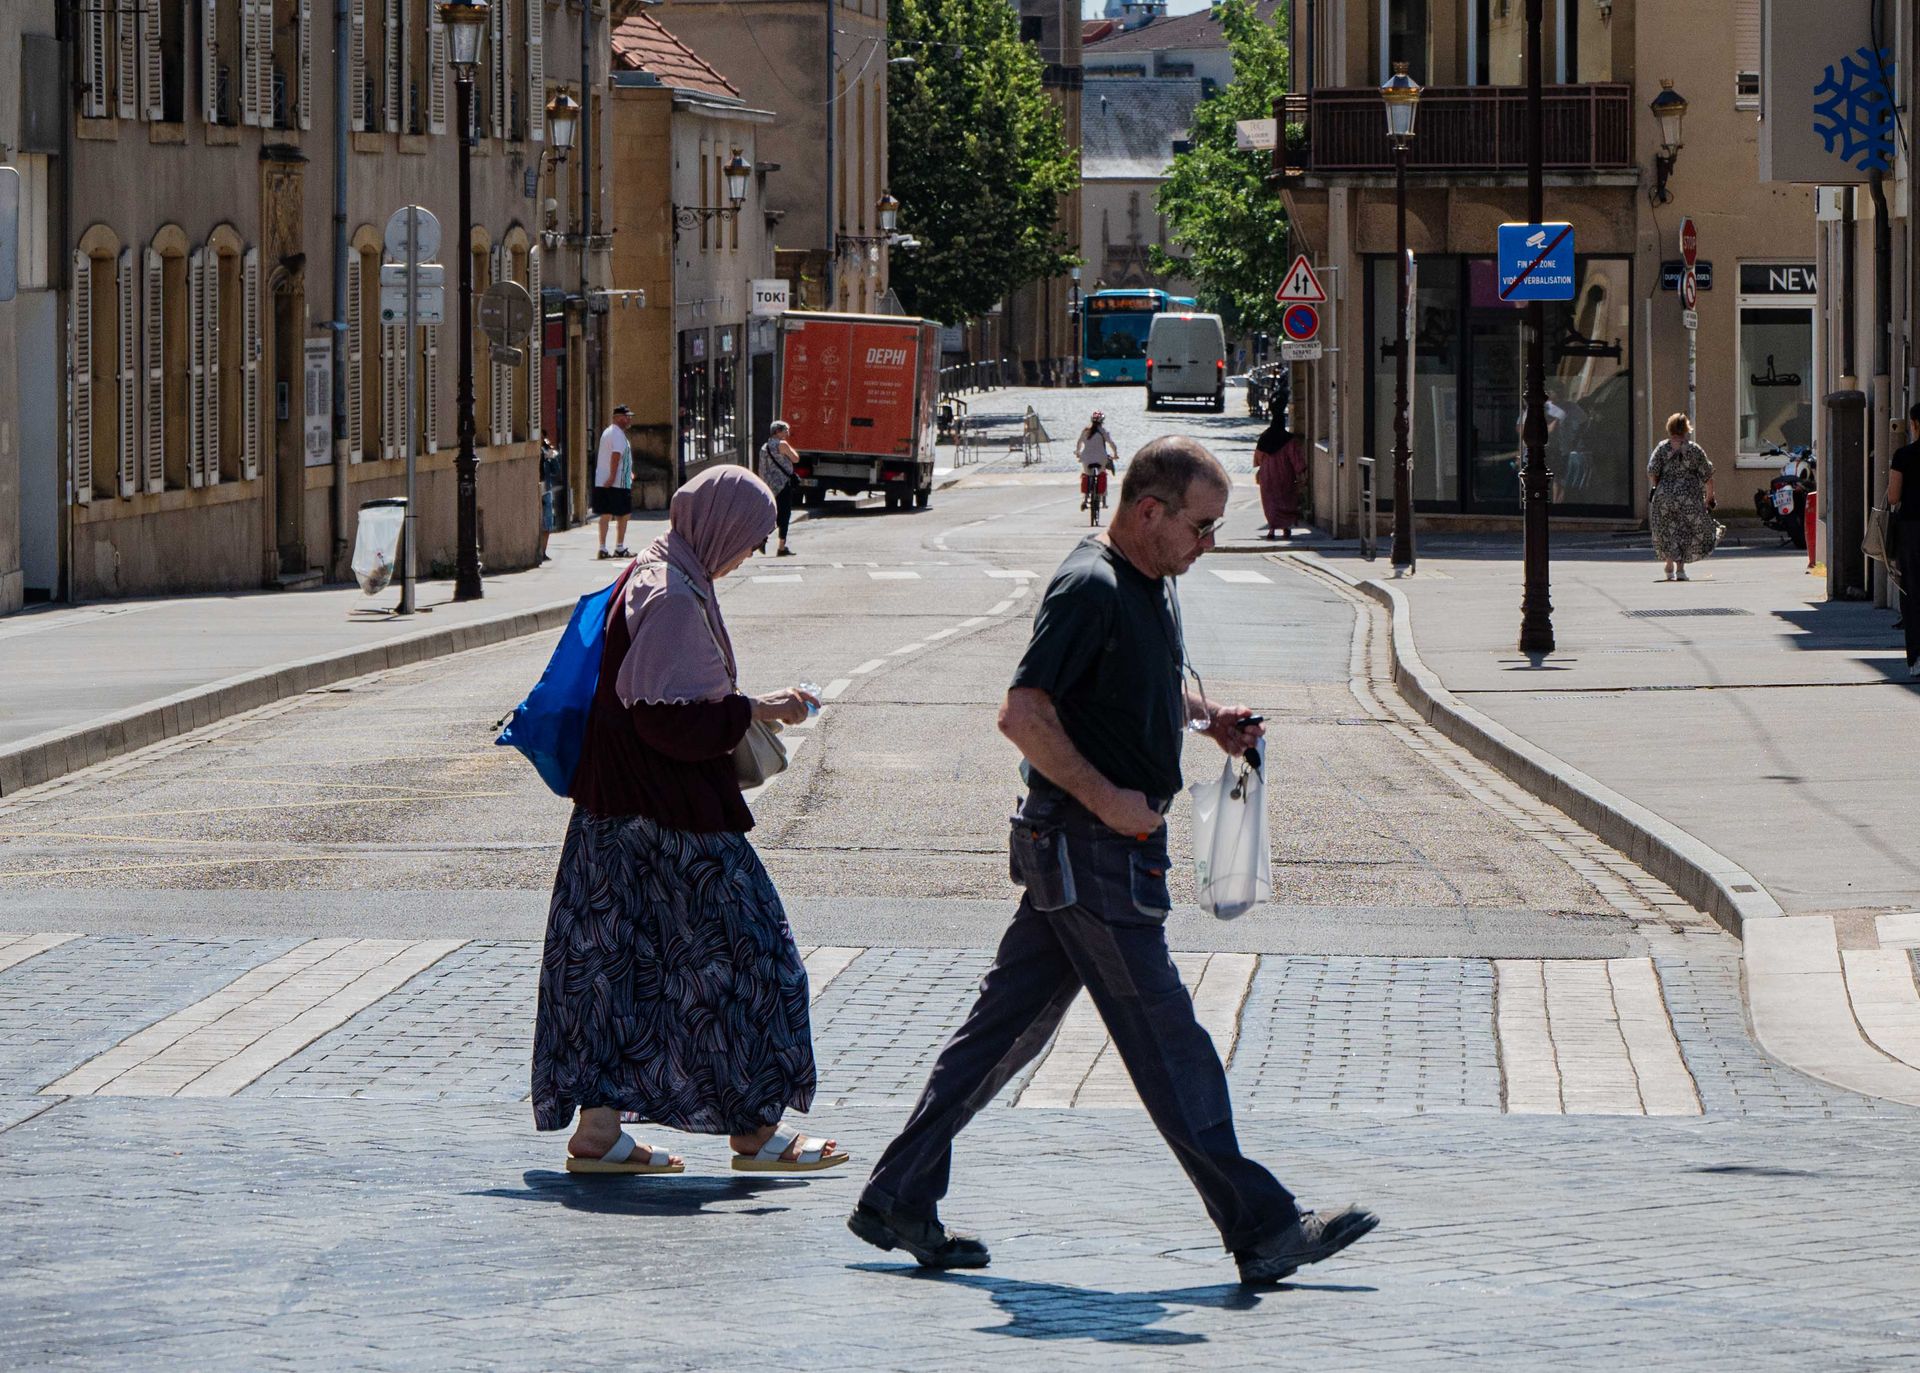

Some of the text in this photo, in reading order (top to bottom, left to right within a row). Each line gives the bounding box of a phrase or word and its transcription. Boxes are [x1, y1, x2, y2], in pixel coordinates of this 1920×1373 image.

[1683, 235, 1697, 250] STOP
[1517, 259, 1528, 269] FIN
[1539, 259, 1556, 269] ZONE
[1502, 275, 1572, 285] VIDÉ VERBALISATION
[1769, 267, 1818, 291] NEW
[866, 348, 907, 366] DEPHI
